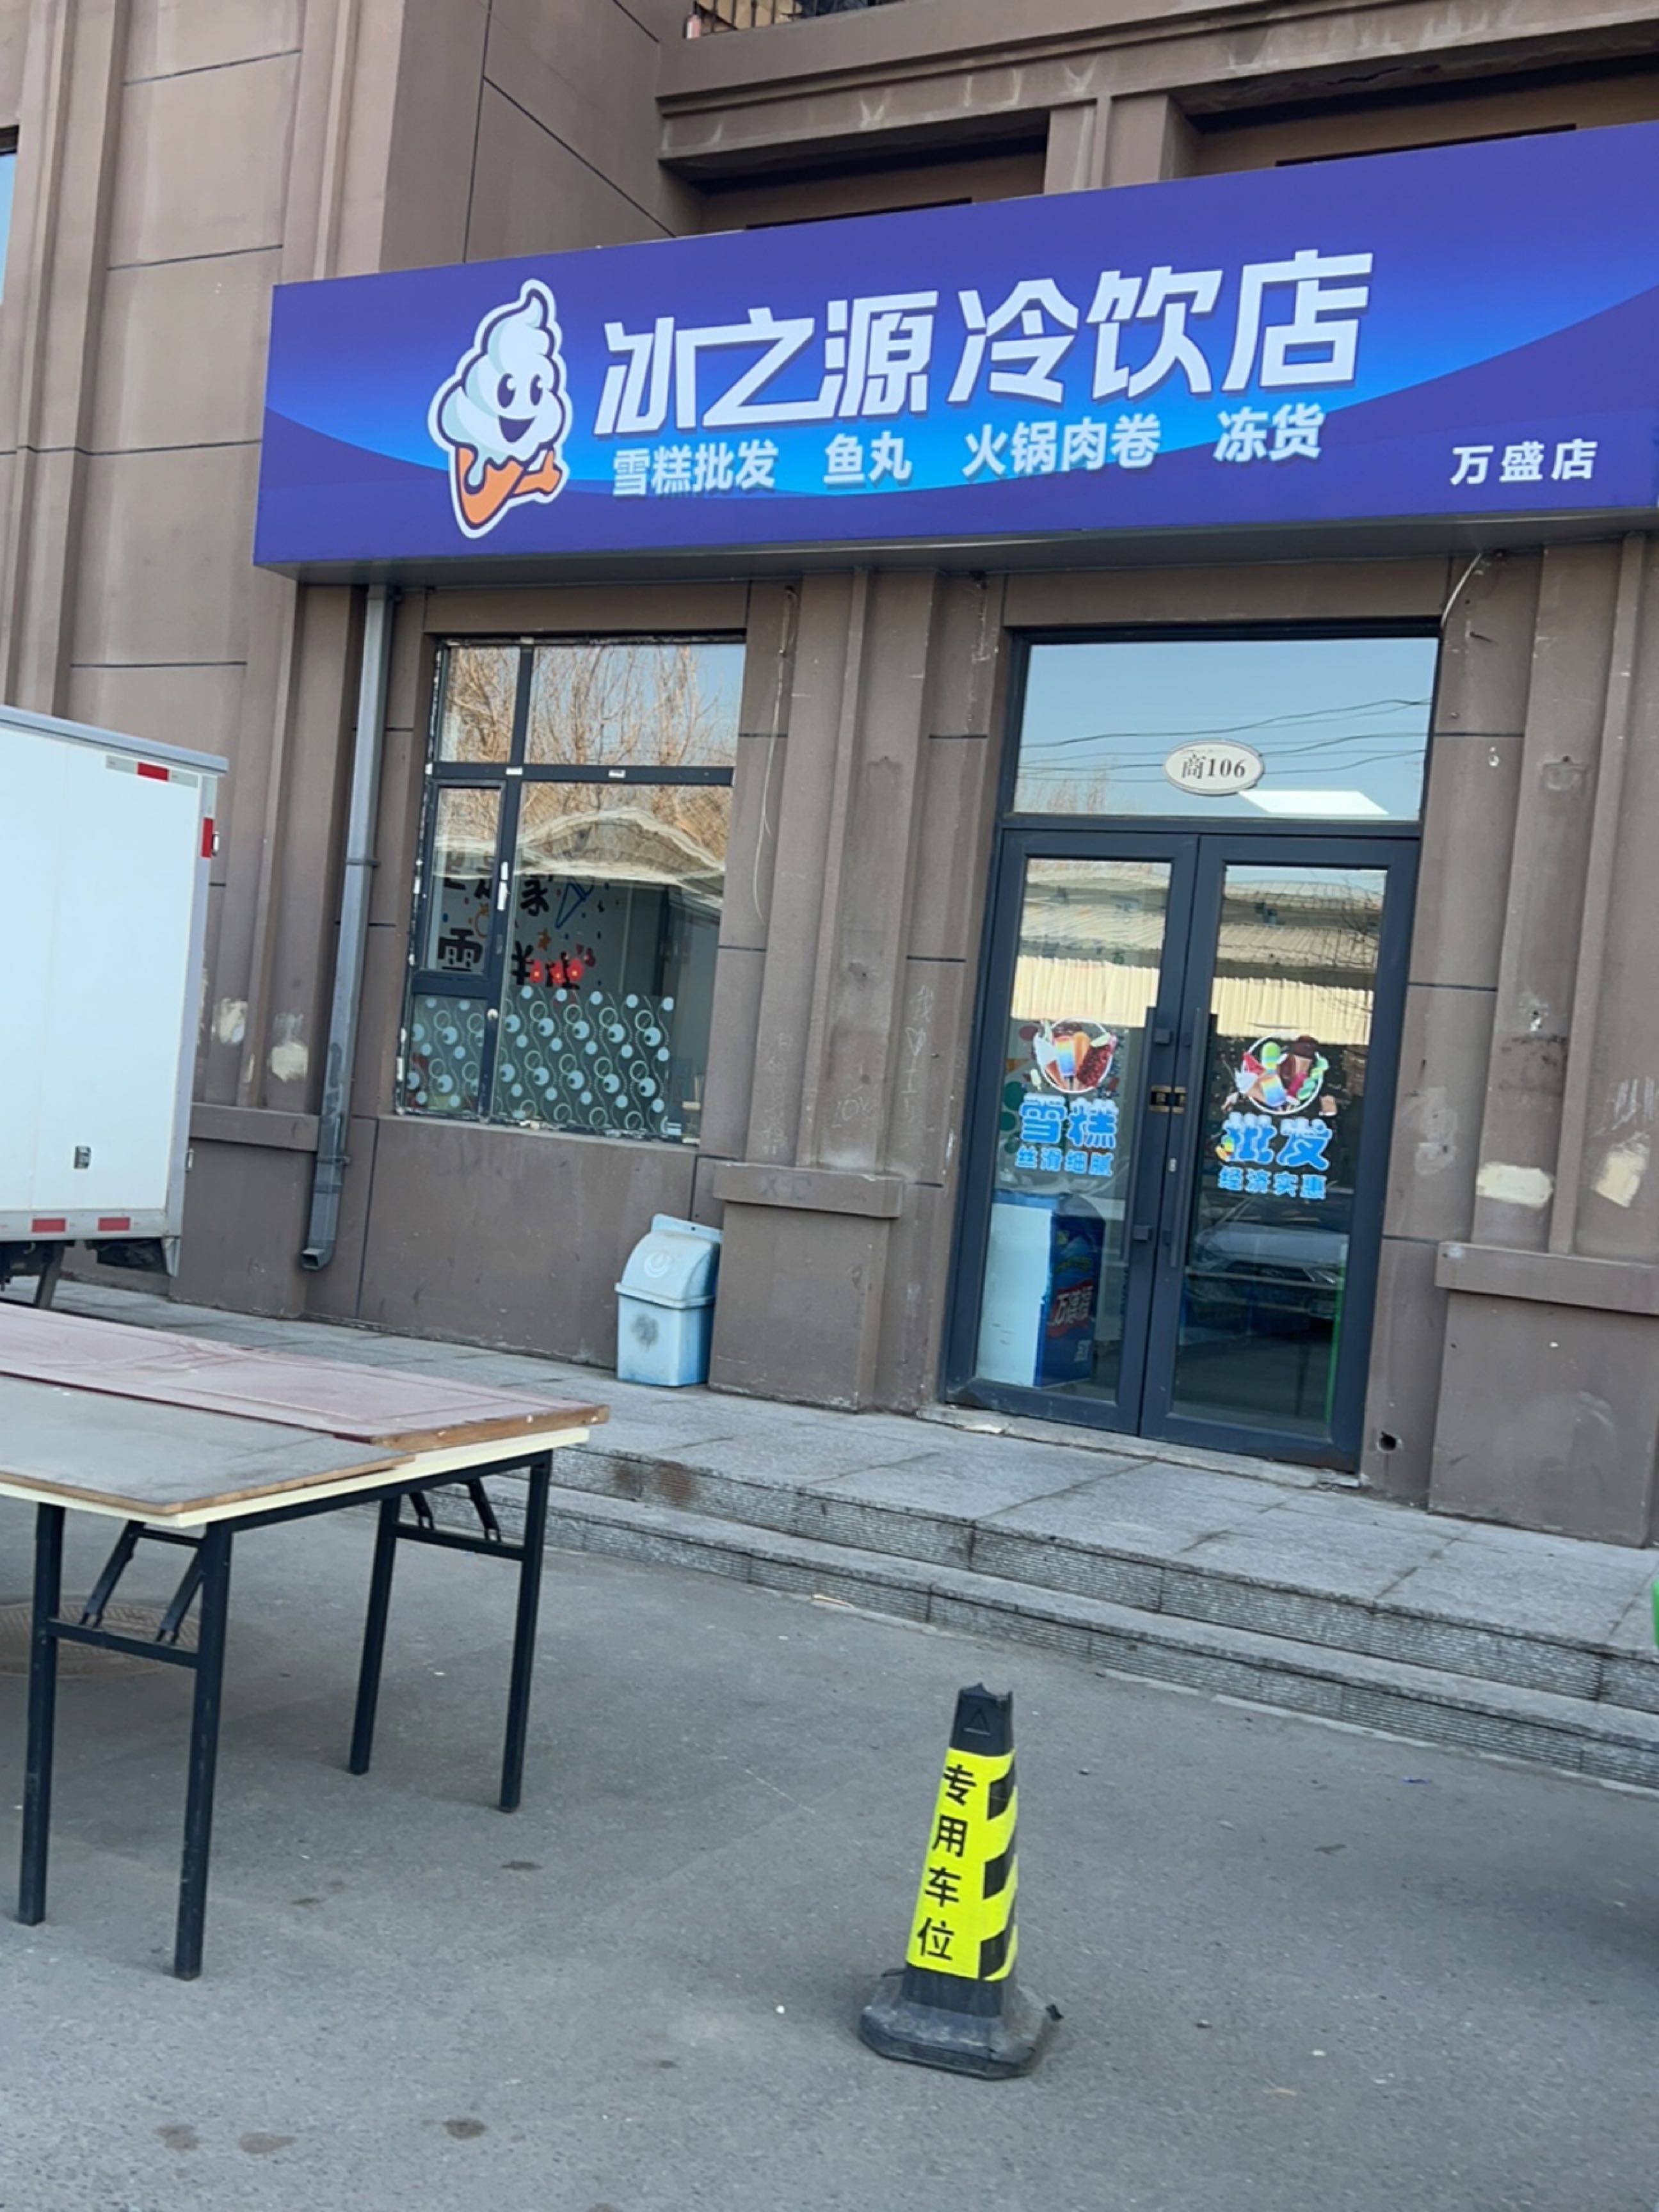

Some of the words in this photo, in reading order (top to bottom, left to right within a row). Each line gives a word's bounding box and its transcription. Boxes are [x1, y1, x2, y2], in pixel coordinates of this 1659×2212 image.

[594, 248, 1374, 435] 冰之源冷饮店
[613, 438, 779, 497] 雪糕批发
[823, 430, 913, 483] 鱼丸
[961, 413, 1162, 477] 火锅肉卷
[1213, 403, 1325, 462] 冻货
[1450, 438, 1598, 485] 万盛店
[1020, 1093, 1118, 1149] 雪糕
[1221, 1112, 1333, 1171] 批发
[1217, 1166, 1327, 1199] 经济实惠
[917, 1764, 977, 1960] 专用车位
